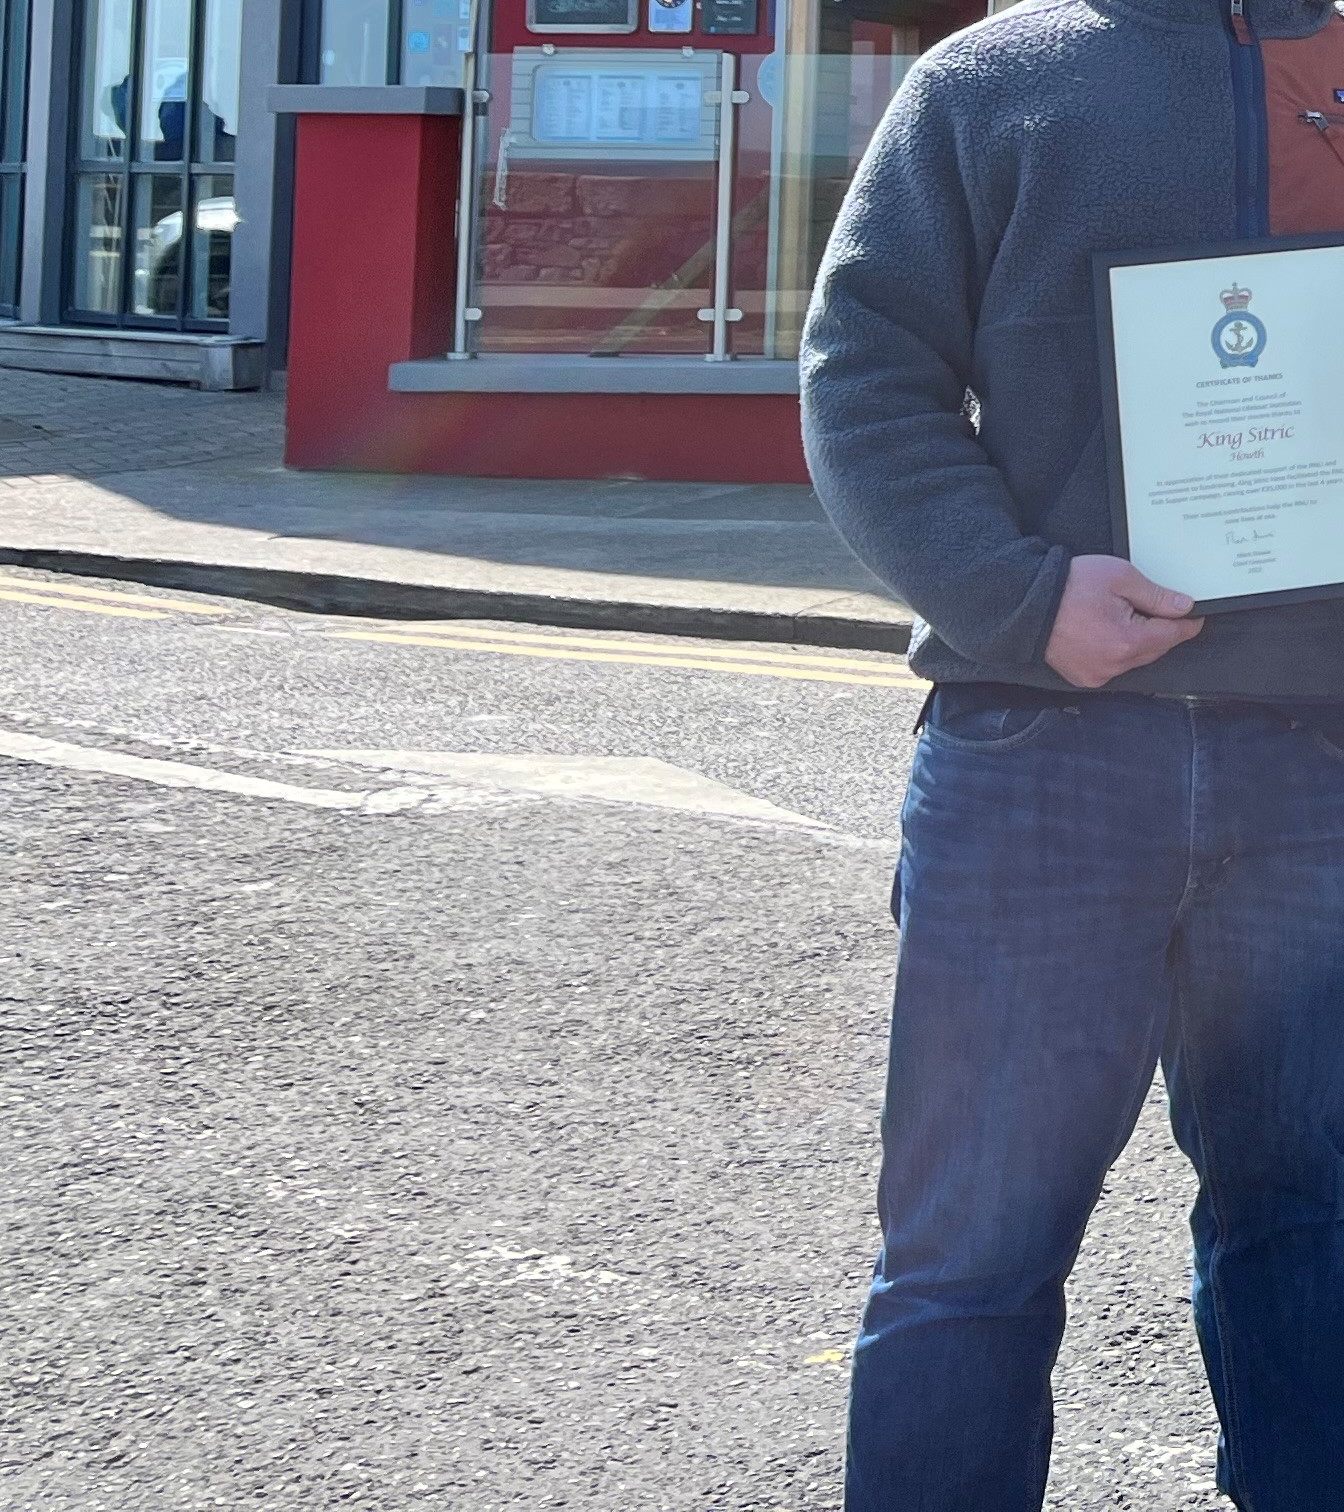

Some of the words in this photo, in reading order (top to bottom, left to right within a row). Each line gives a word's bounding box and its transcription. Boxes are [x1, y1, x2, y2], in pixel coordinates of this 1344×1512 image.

[1197, 431, 1242, 450] King
[1247, 425, 1295, 443] Sitric
[1229, 448, 1265, 462] Howth
